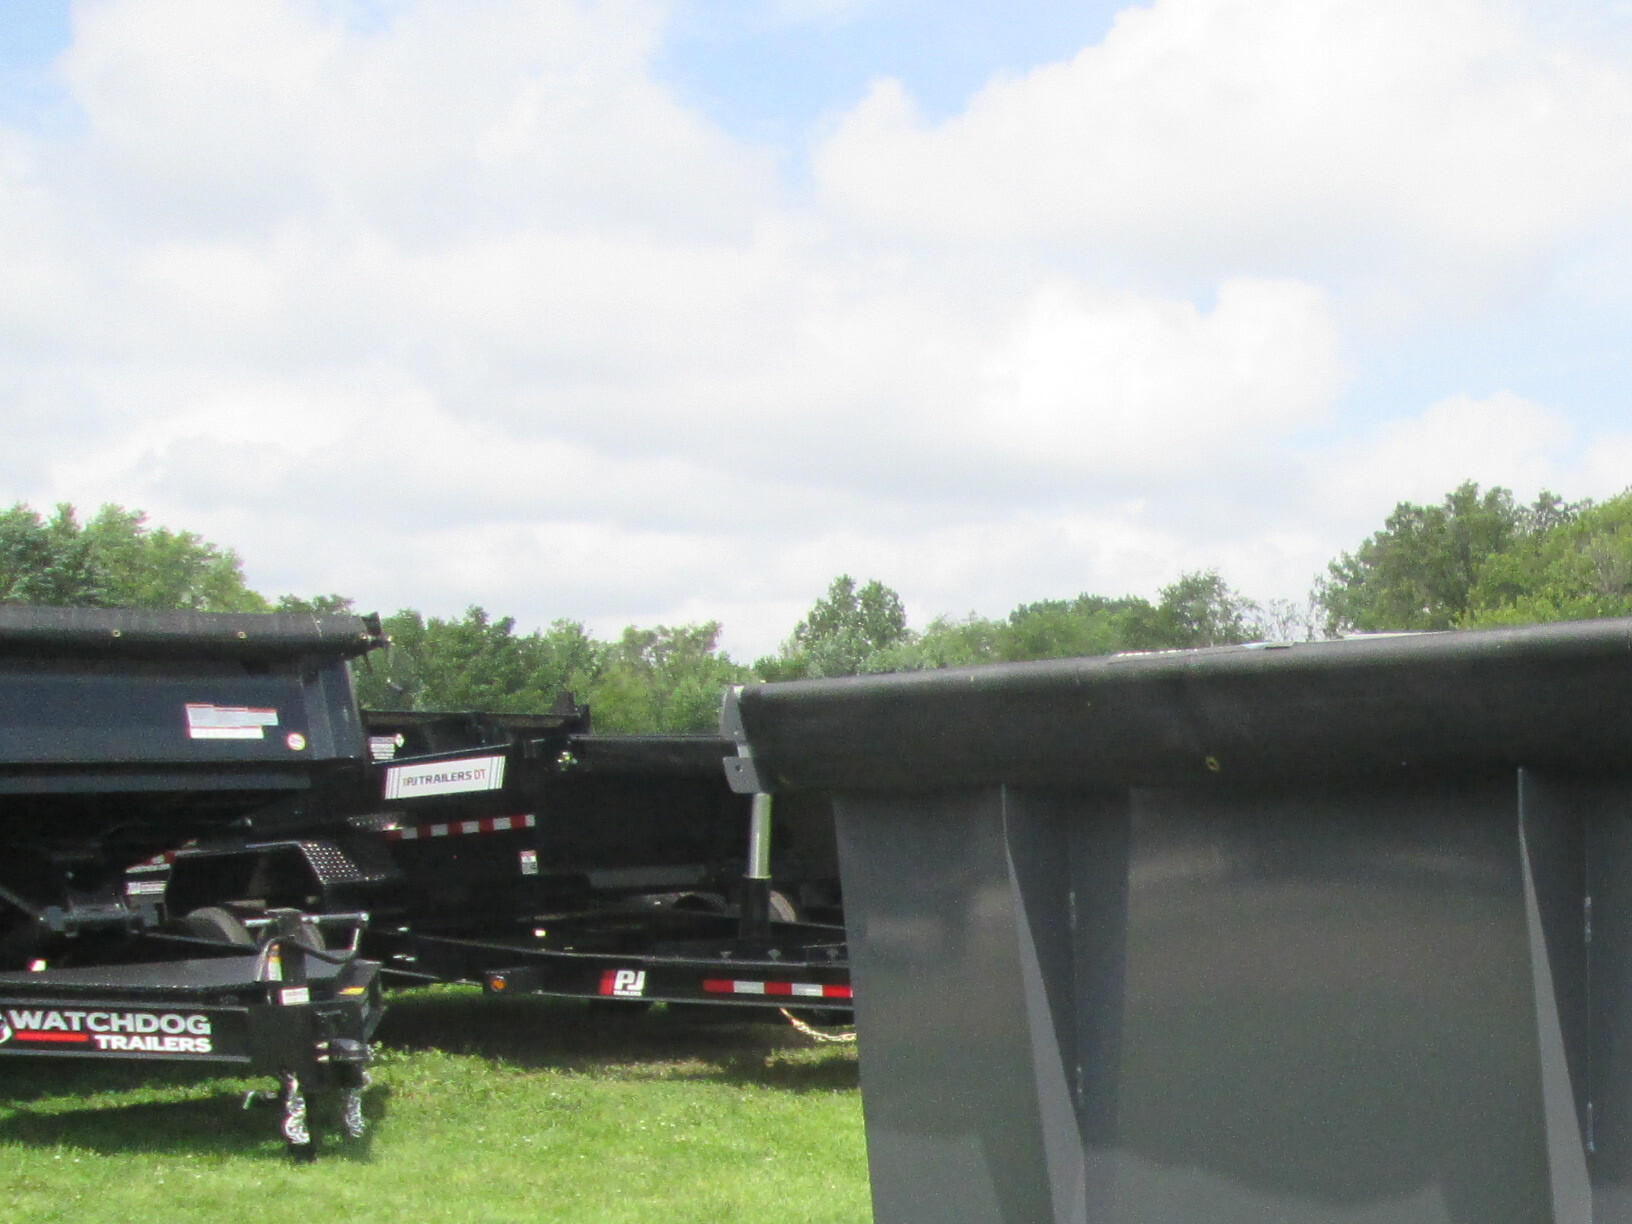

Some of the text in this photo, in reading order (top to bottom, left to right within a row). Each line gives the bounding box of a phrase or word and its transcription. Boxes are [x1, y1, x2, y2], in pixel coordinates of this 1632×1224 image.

[420, 770, 473, 785] TRAILERS
[613, 970, 646, 991] PJ
[8, 1009, 212, 1035] WATCHDOG
[94, 1034, 213, 1053] TRAILERS
